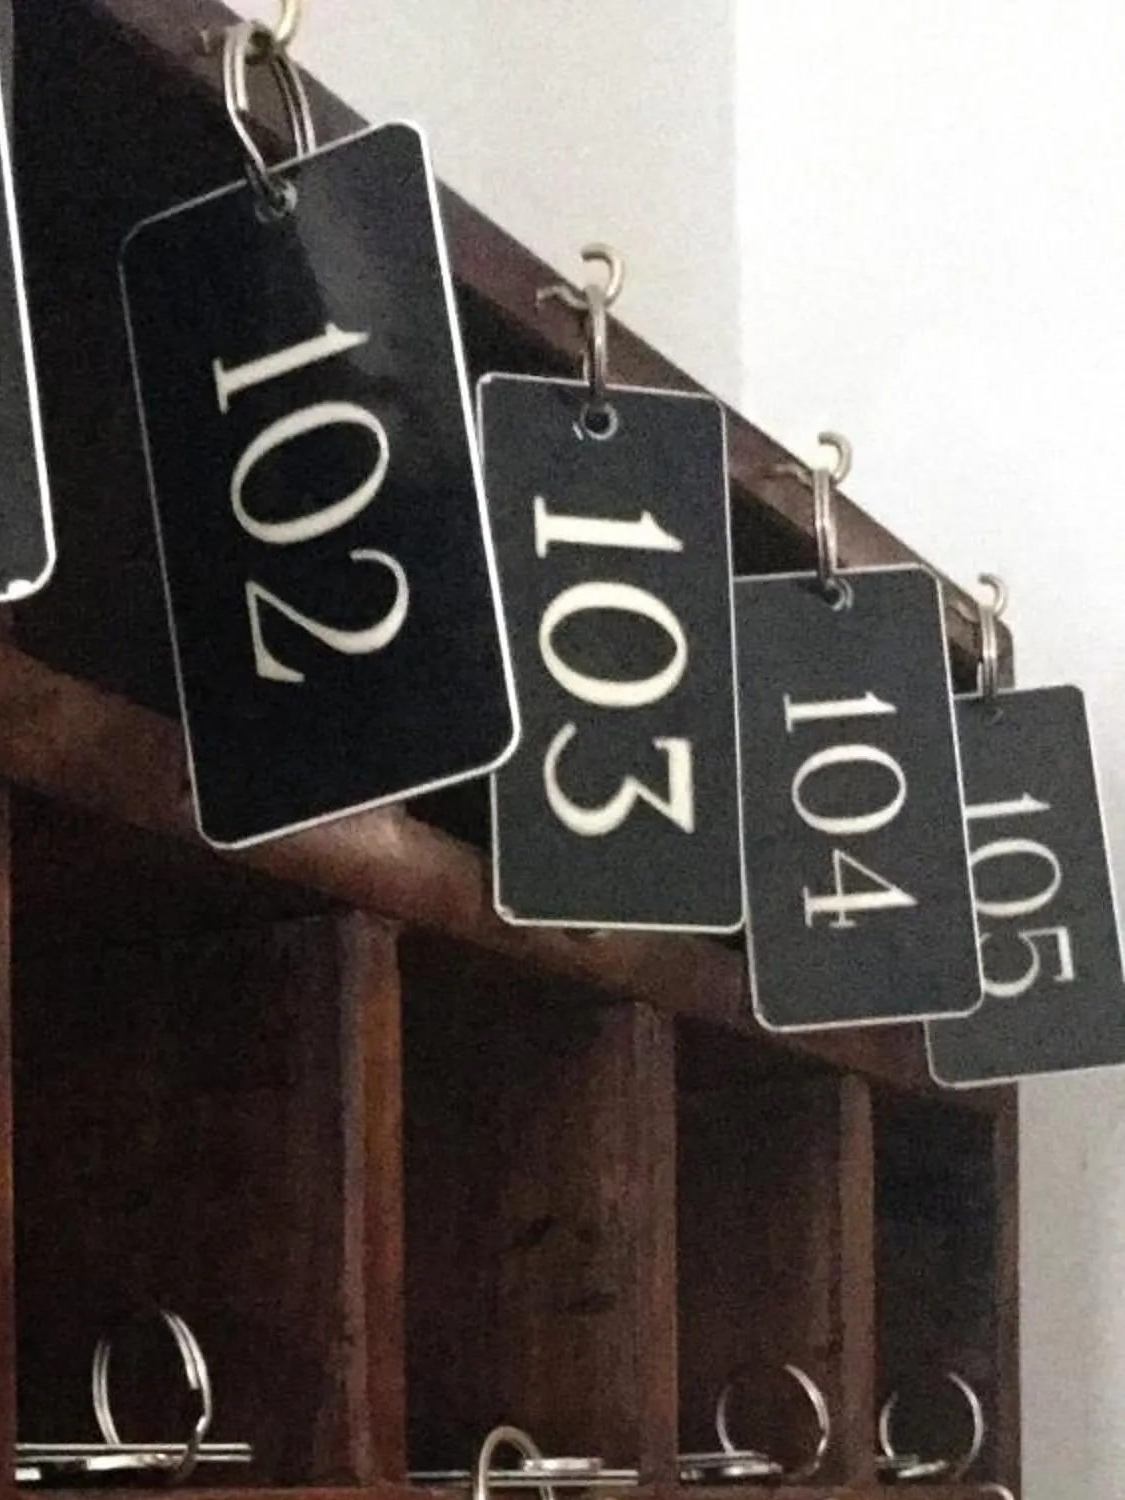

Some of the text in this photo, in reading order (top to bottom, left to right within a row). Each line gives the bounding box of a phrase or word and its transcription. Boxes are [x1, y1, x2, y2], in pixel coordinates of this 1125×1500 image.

[215, 323, 409, 682] 102
[534, 497, 694, 835] 103
[784, 692, 917, 929] 104
[966, 793, 1076, 999] 105
